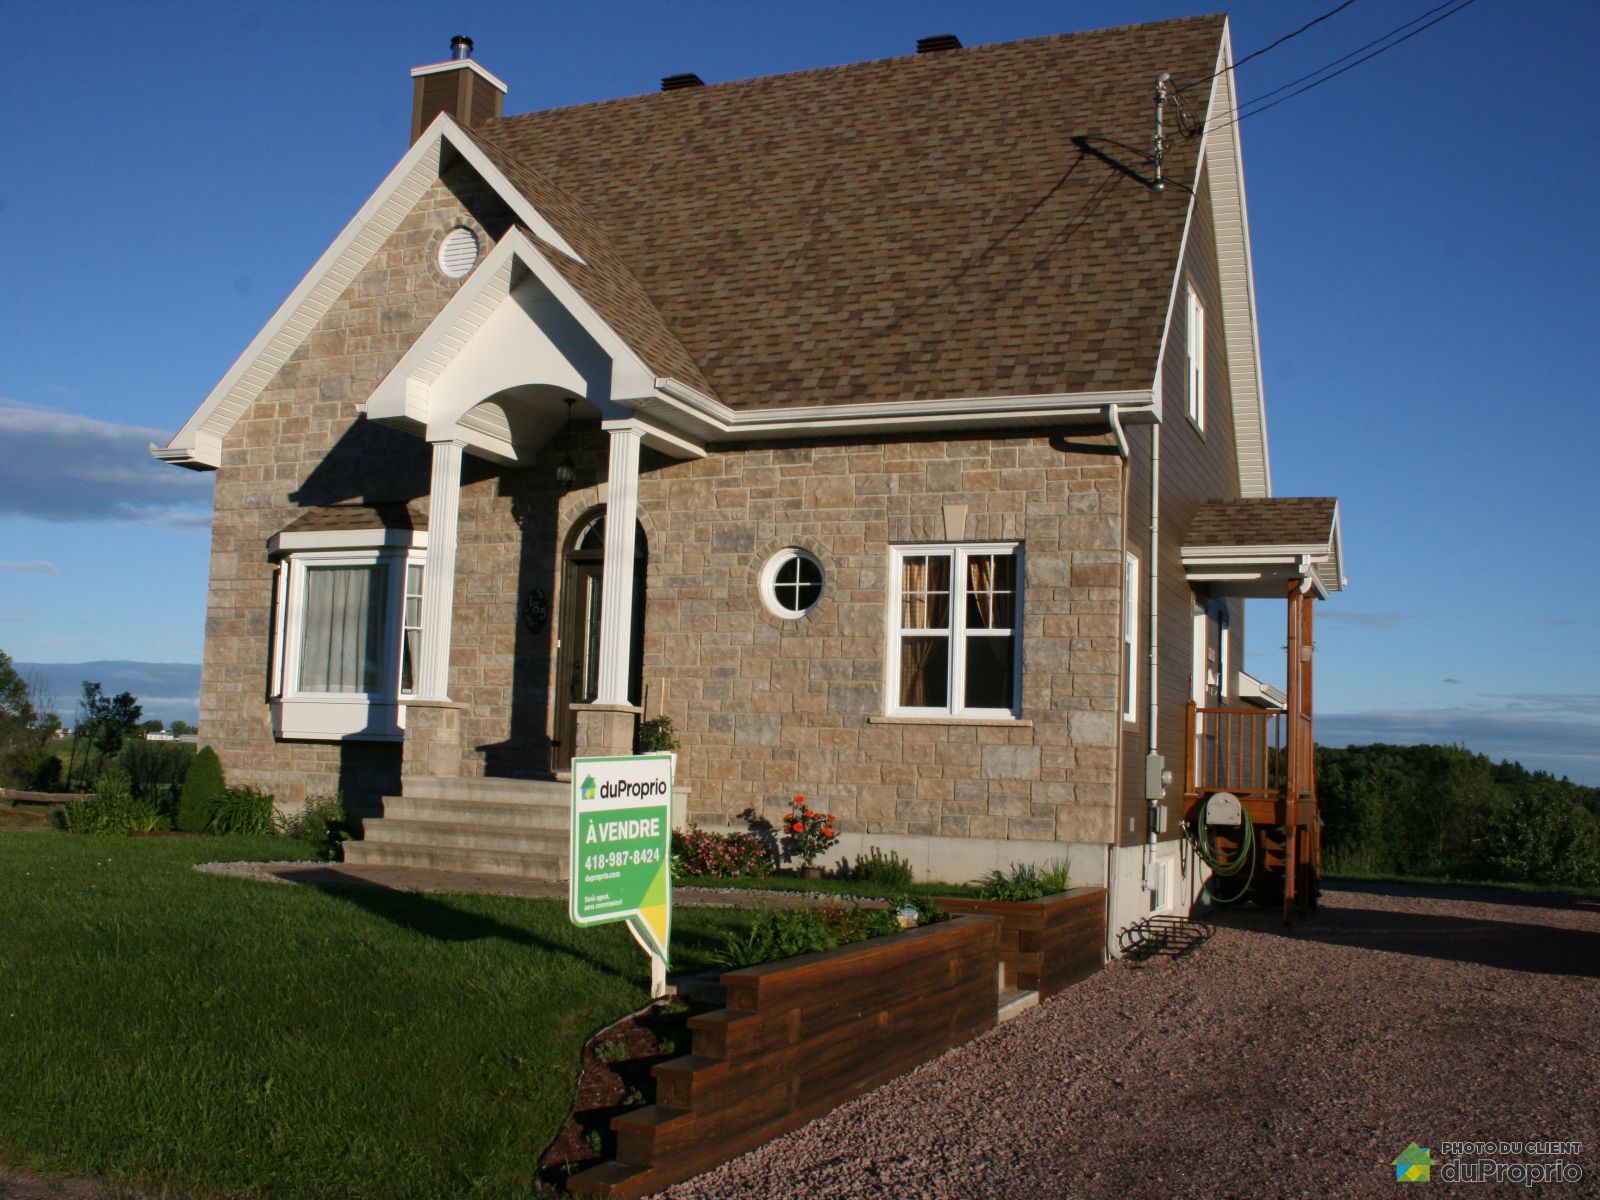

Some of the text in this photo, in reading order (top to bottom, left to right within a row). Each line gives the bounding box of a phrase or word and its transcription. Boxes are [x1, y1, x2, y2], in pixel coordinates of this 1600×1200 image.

[600, 778, 667, 800] duProprio
[585, 818, 660, 844] À VENDRE
